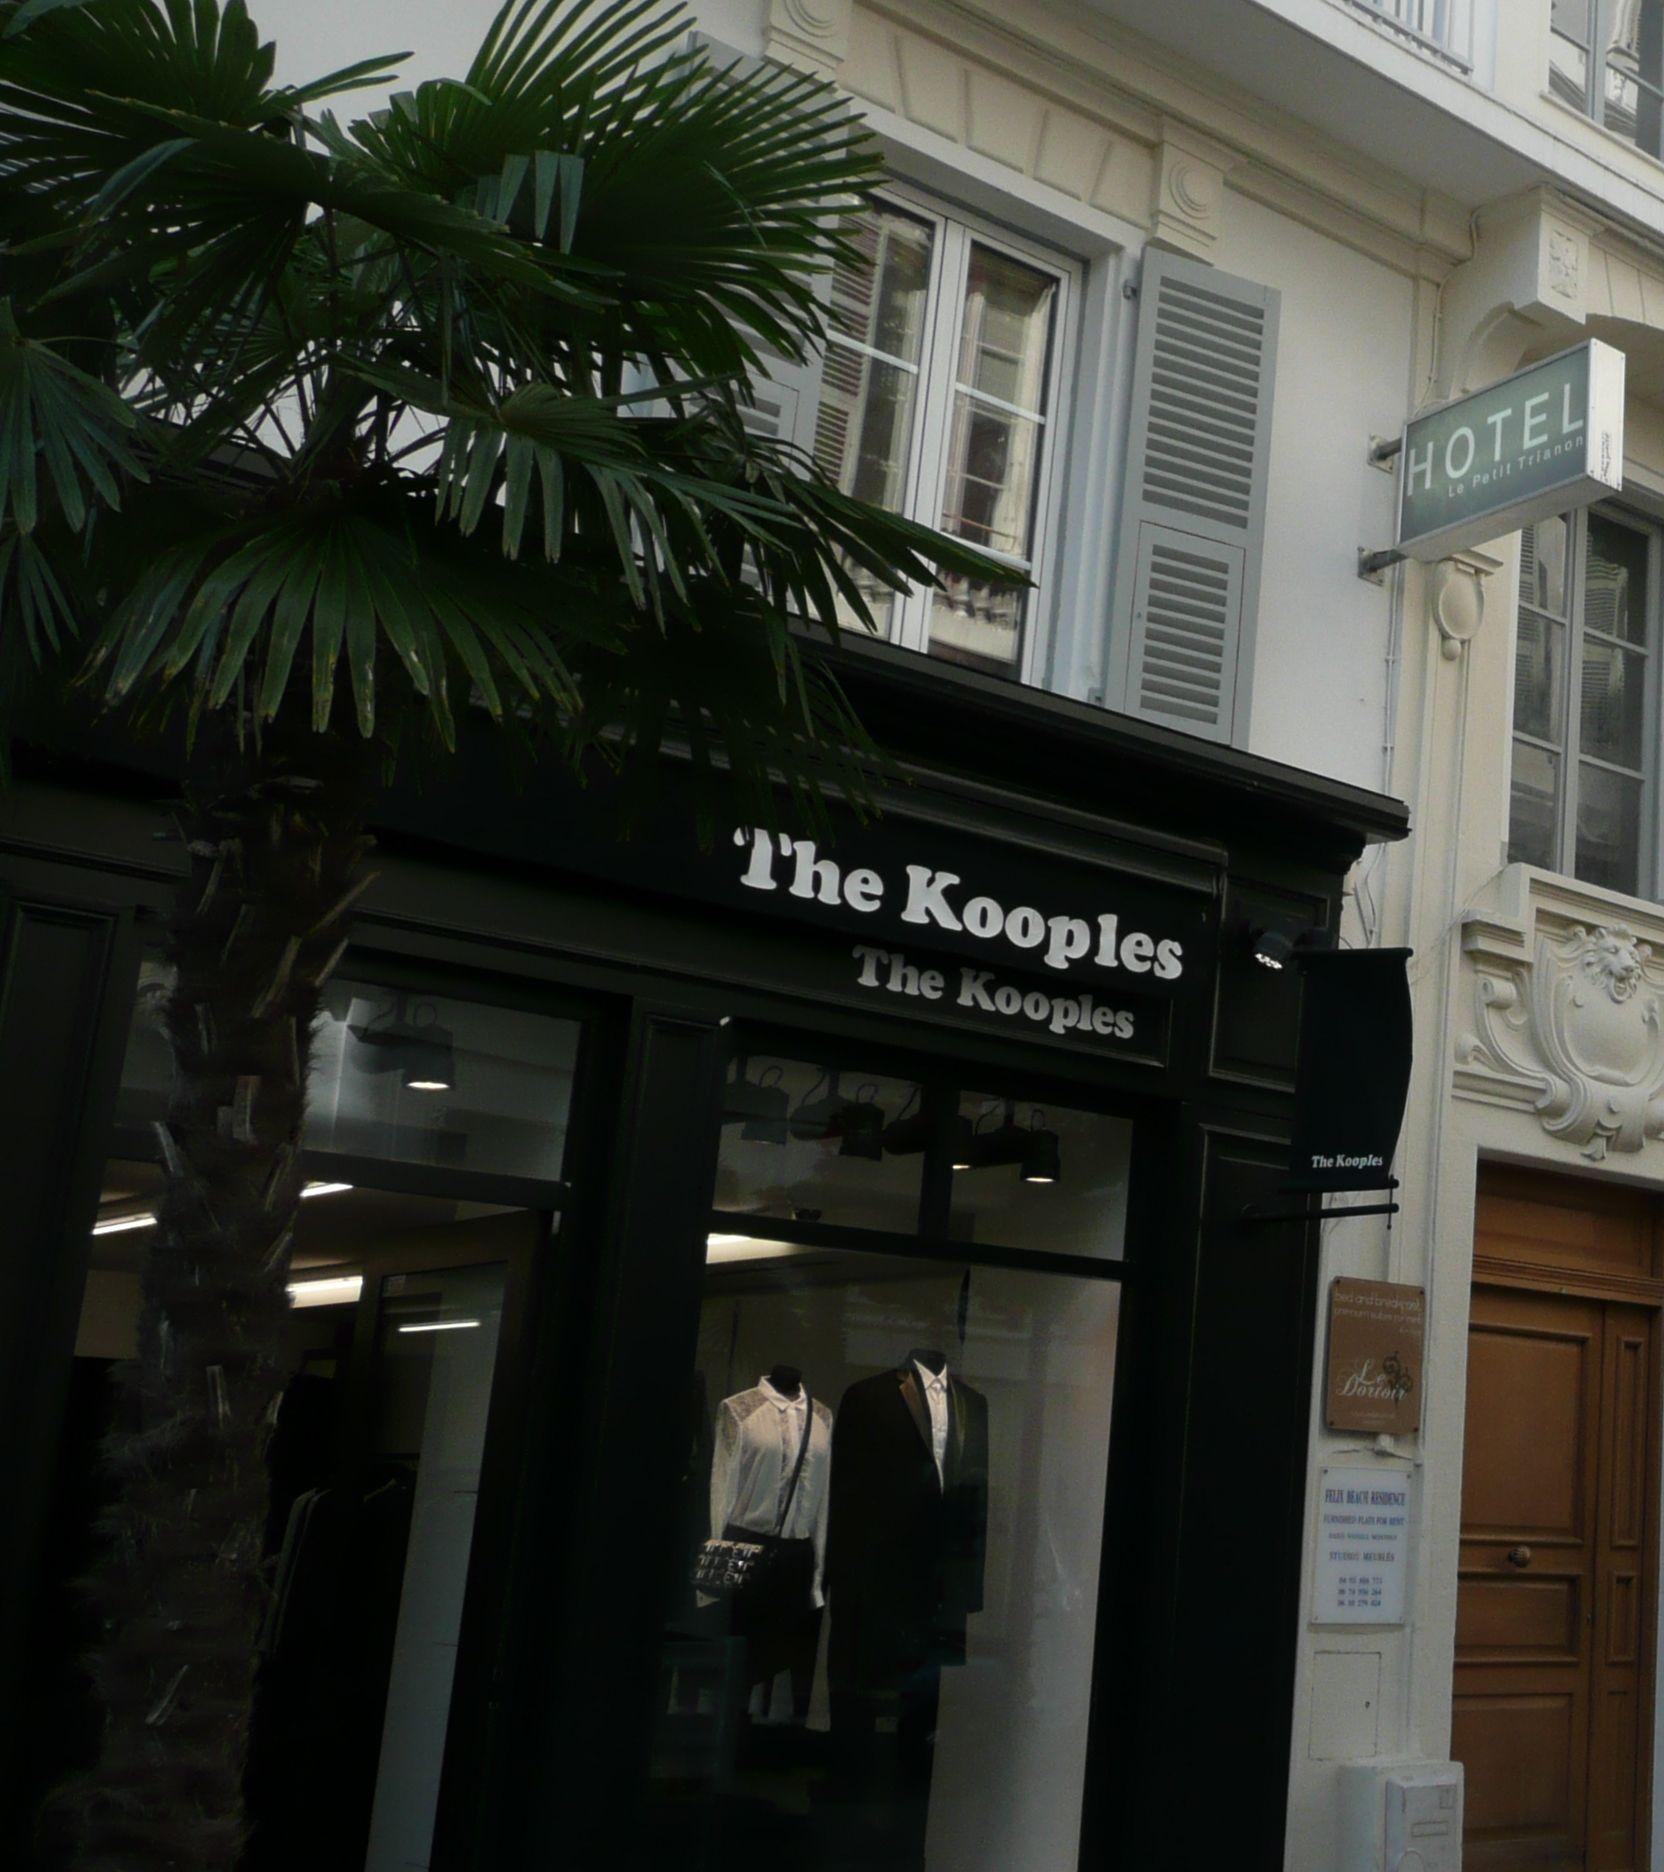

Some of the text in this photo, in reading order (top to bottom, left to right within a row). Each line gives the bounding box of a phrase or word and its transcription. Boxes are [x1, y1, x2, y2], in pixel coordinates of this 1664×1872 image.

[1406, 383, 1584, 497] HOTEL
[1448, 483, 1465, 498] Le
[1472, 462, 1511, 488] Petit
[1518, 436, 1584, 470] Trianon
[733, 827, 1183, 980] The Kooples
[852, 944, 1134, 1039] The Kooples
[1311, 1154, 1383, 1169] The Kooples
